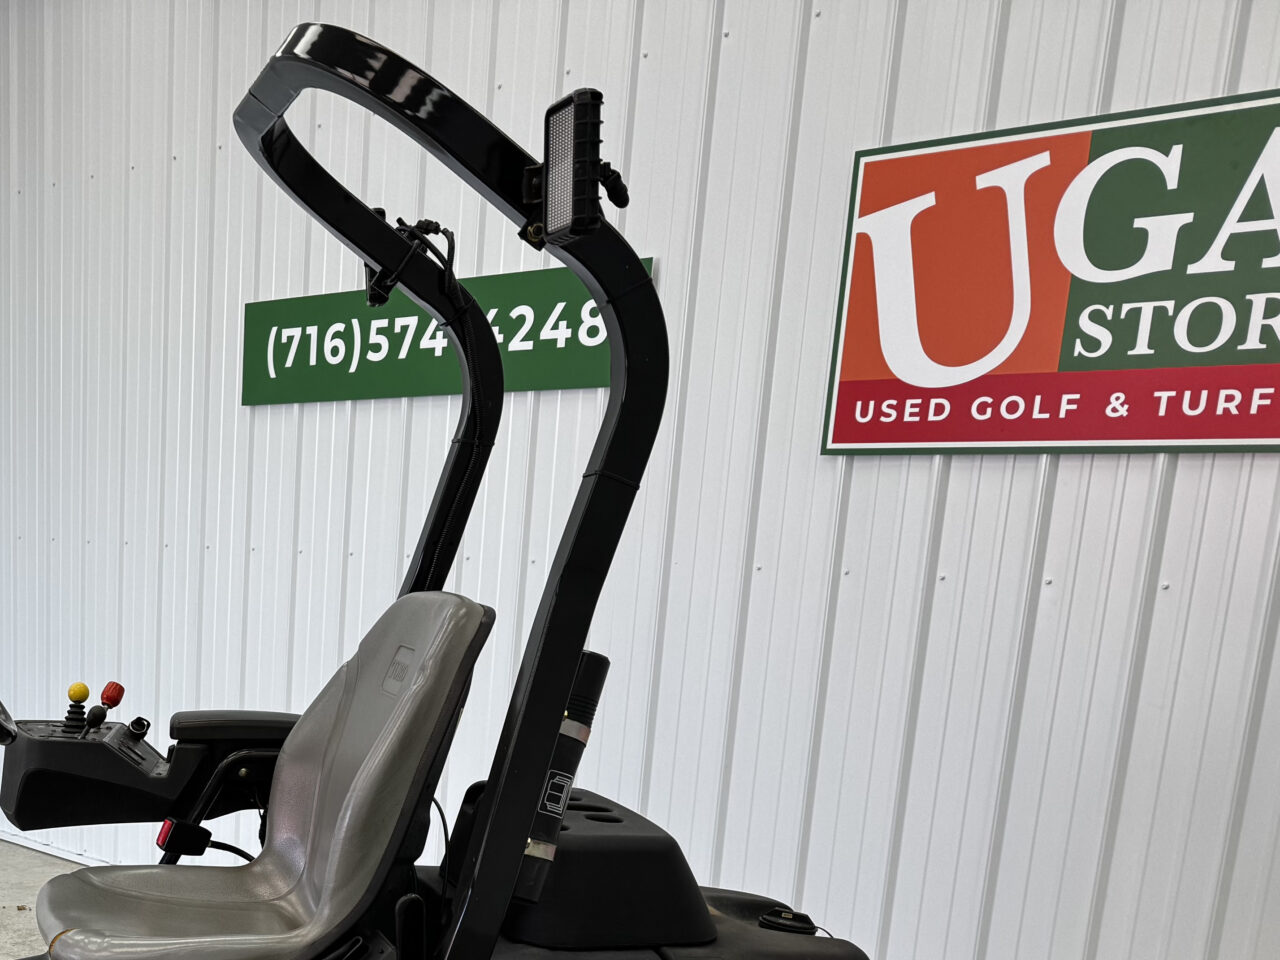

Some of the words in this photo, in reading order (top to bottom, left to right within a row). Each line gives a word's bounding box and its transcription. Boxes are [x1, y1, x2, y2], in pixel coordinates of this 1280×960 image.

[854, 397, 952, 424] USED
[970, 393, 1081, 421] GOLF
[1104, 391, 1130, 418] &
[1153, 387, 1276, 417] TURF
